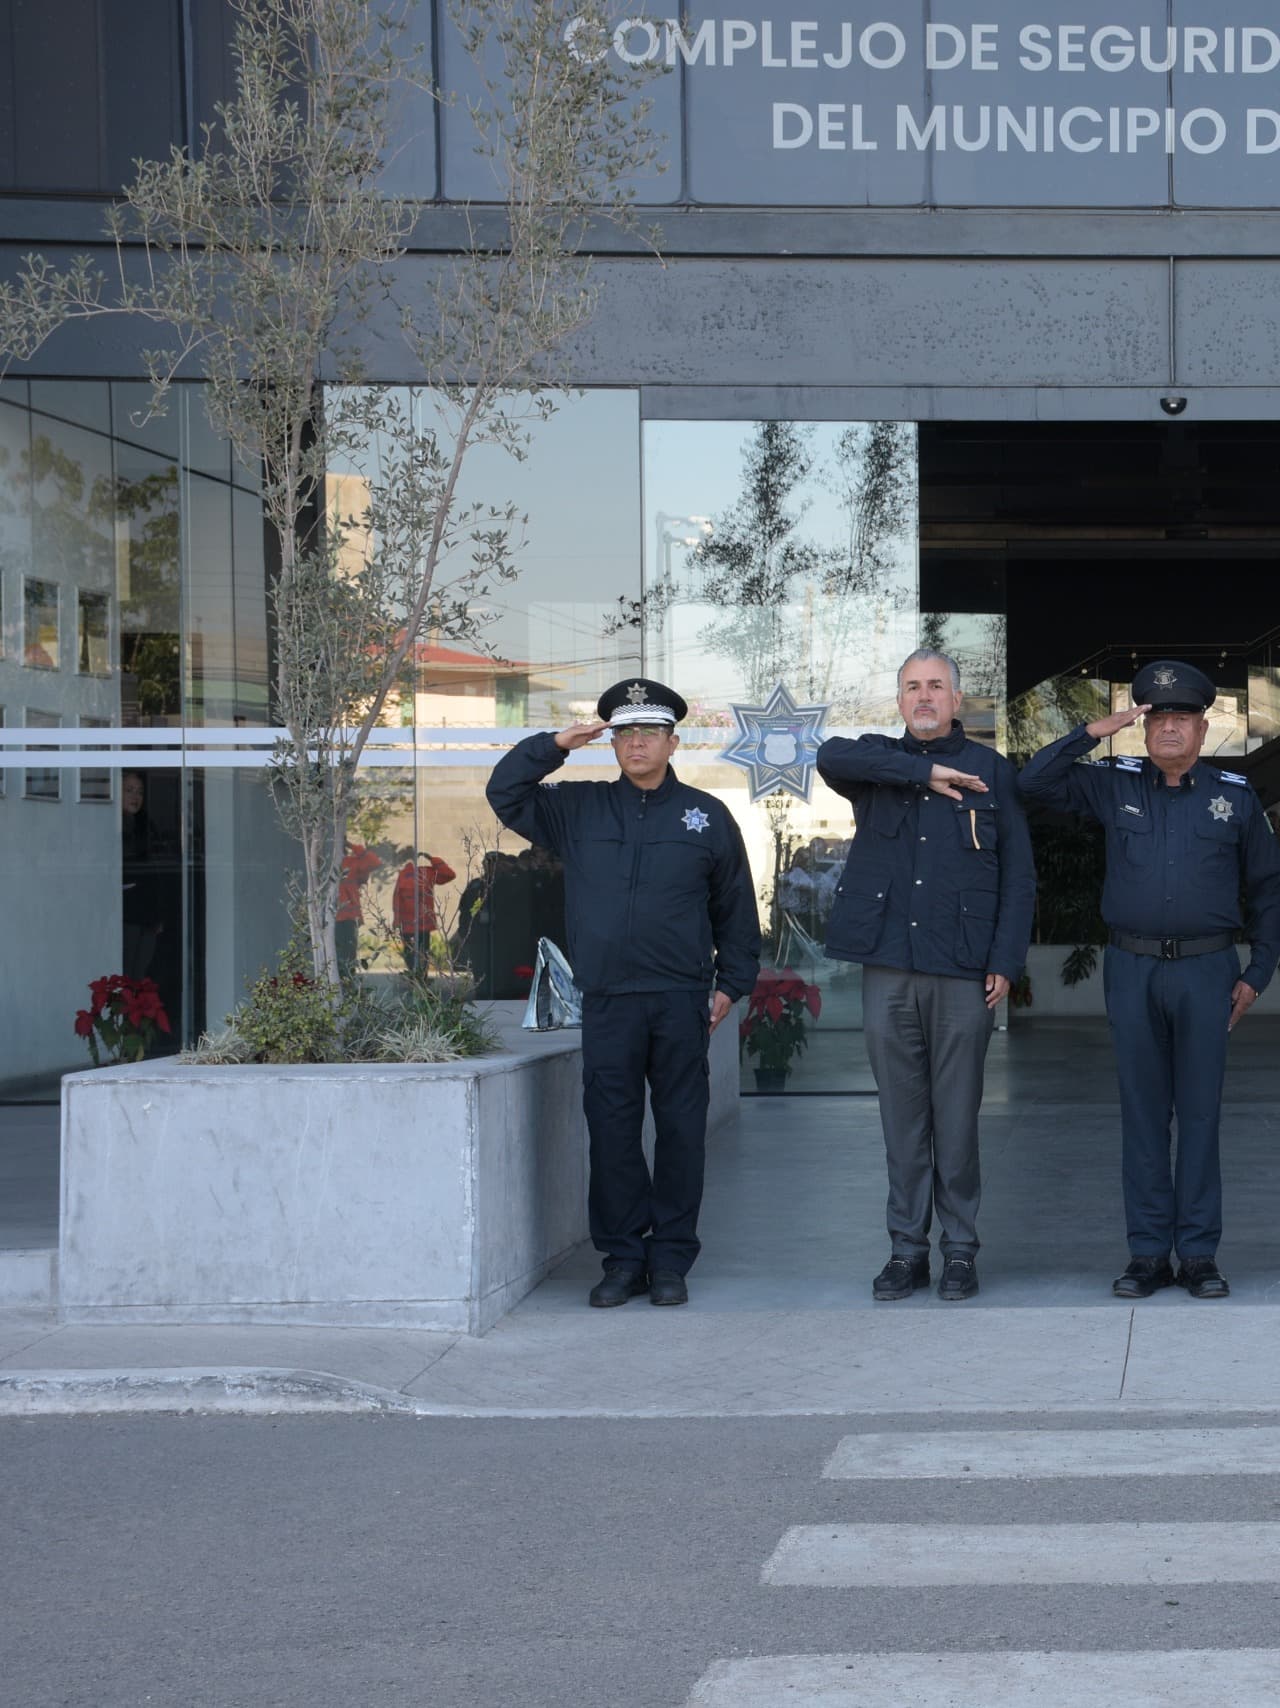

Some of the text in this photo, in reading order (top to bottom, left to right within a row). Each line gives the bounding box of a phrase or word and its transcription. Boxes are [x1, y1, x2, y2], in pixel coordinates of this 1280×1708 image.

[563, 17, 906, 69] COMPLEJO
[926, 23, 999, 71] DE
[772, 102, 878, 150] DEL
[896, 104, 1227, 155] MUNICIPIO
